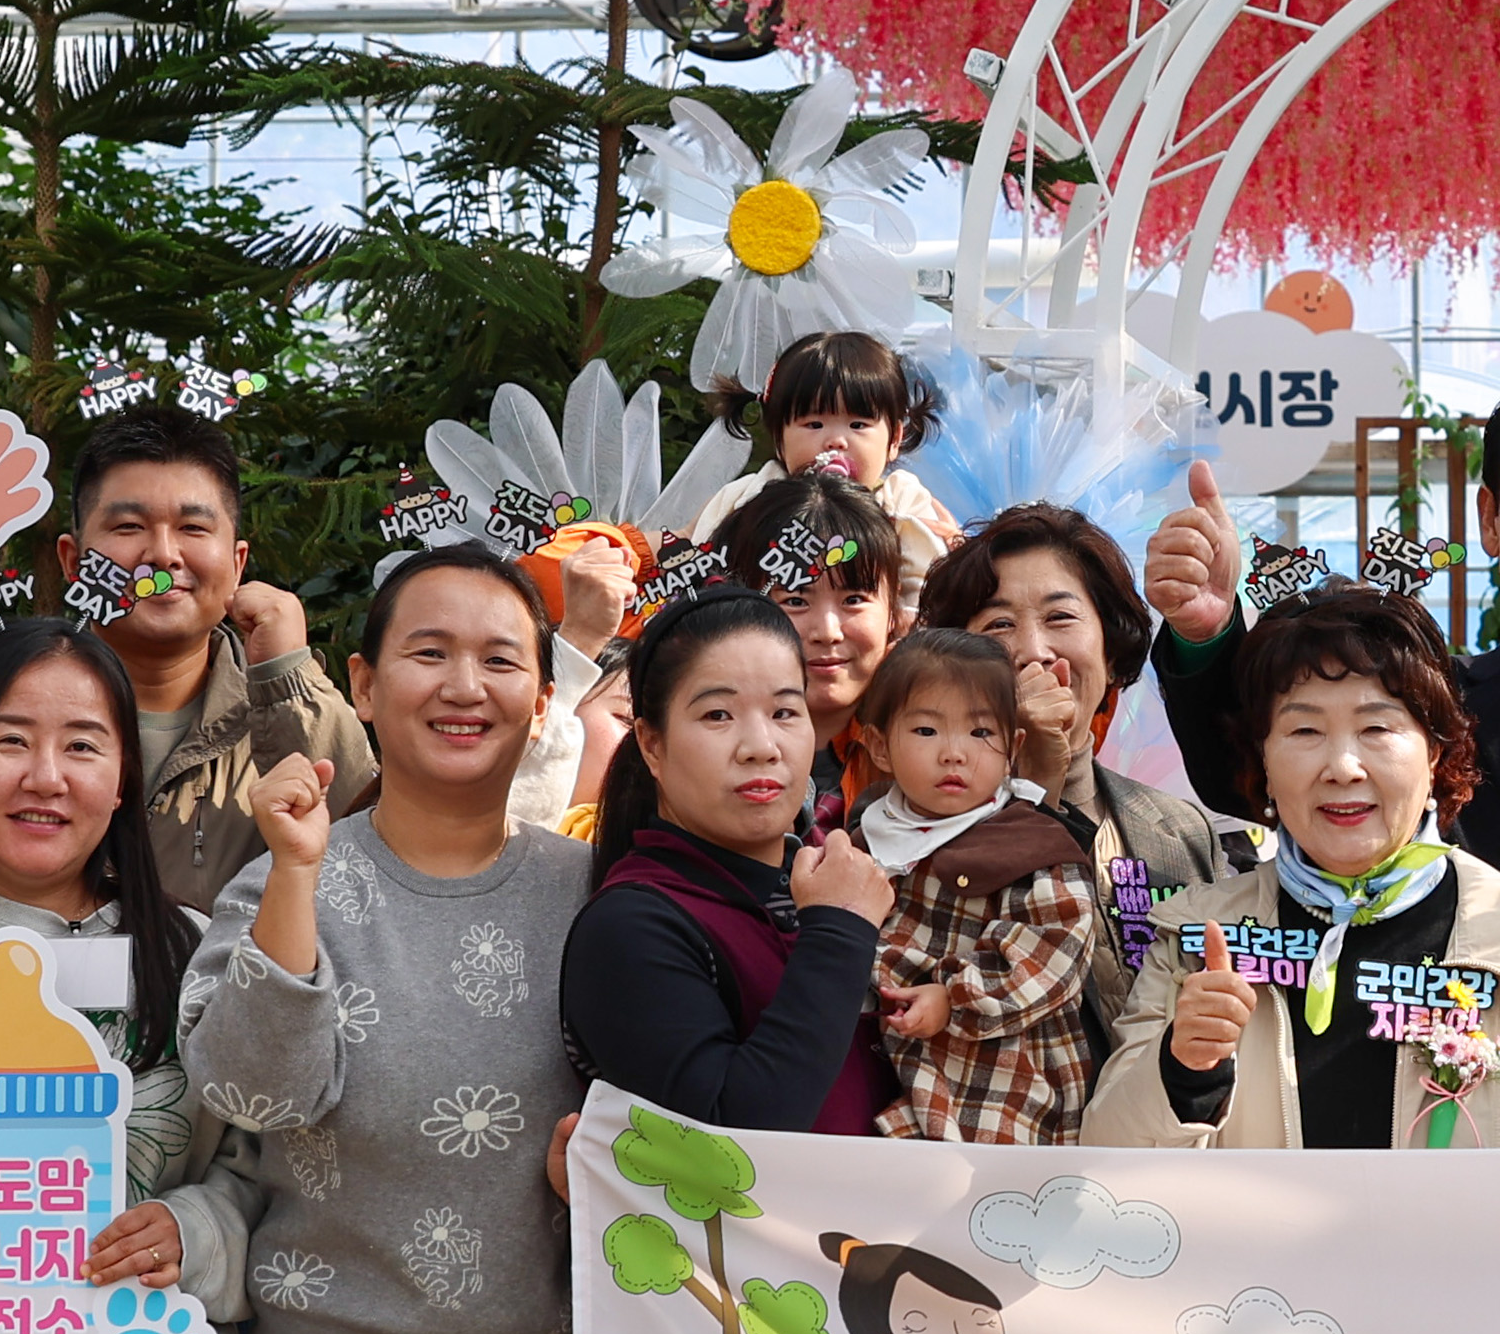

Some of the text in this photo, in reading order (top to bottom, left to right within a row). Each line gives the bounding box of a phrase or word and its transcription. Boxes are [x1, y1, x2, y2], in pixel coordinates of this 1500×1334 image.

[79, 377, 155, 418] HAPPY
[186, 361, 231, 397] 진도
[1194, 369, 1339, 428] 시장
[178, 388, 232, 421] DAY
[379, 496, 467, 542] HAPPY
[497, 482, 550, 524] 진도
[487, 513, 549, 554] DAY
[778, 519, 825, 566] 진도
[1373, 528, 1425, 569] 진도
[80, 550, 131, 596] 진도
[645, 545, 728, 603] HAPPY
[759, 548, 812, 592] DAY
[1247, 550, 1329, 608] HAPPY
[1364, 558, 1424, 597] DAY
[64, 581, 125, 626] DAY
[1198, 952, 1306, 989] 킴이
[1356, 960, 1497, 1009] 군민건강
